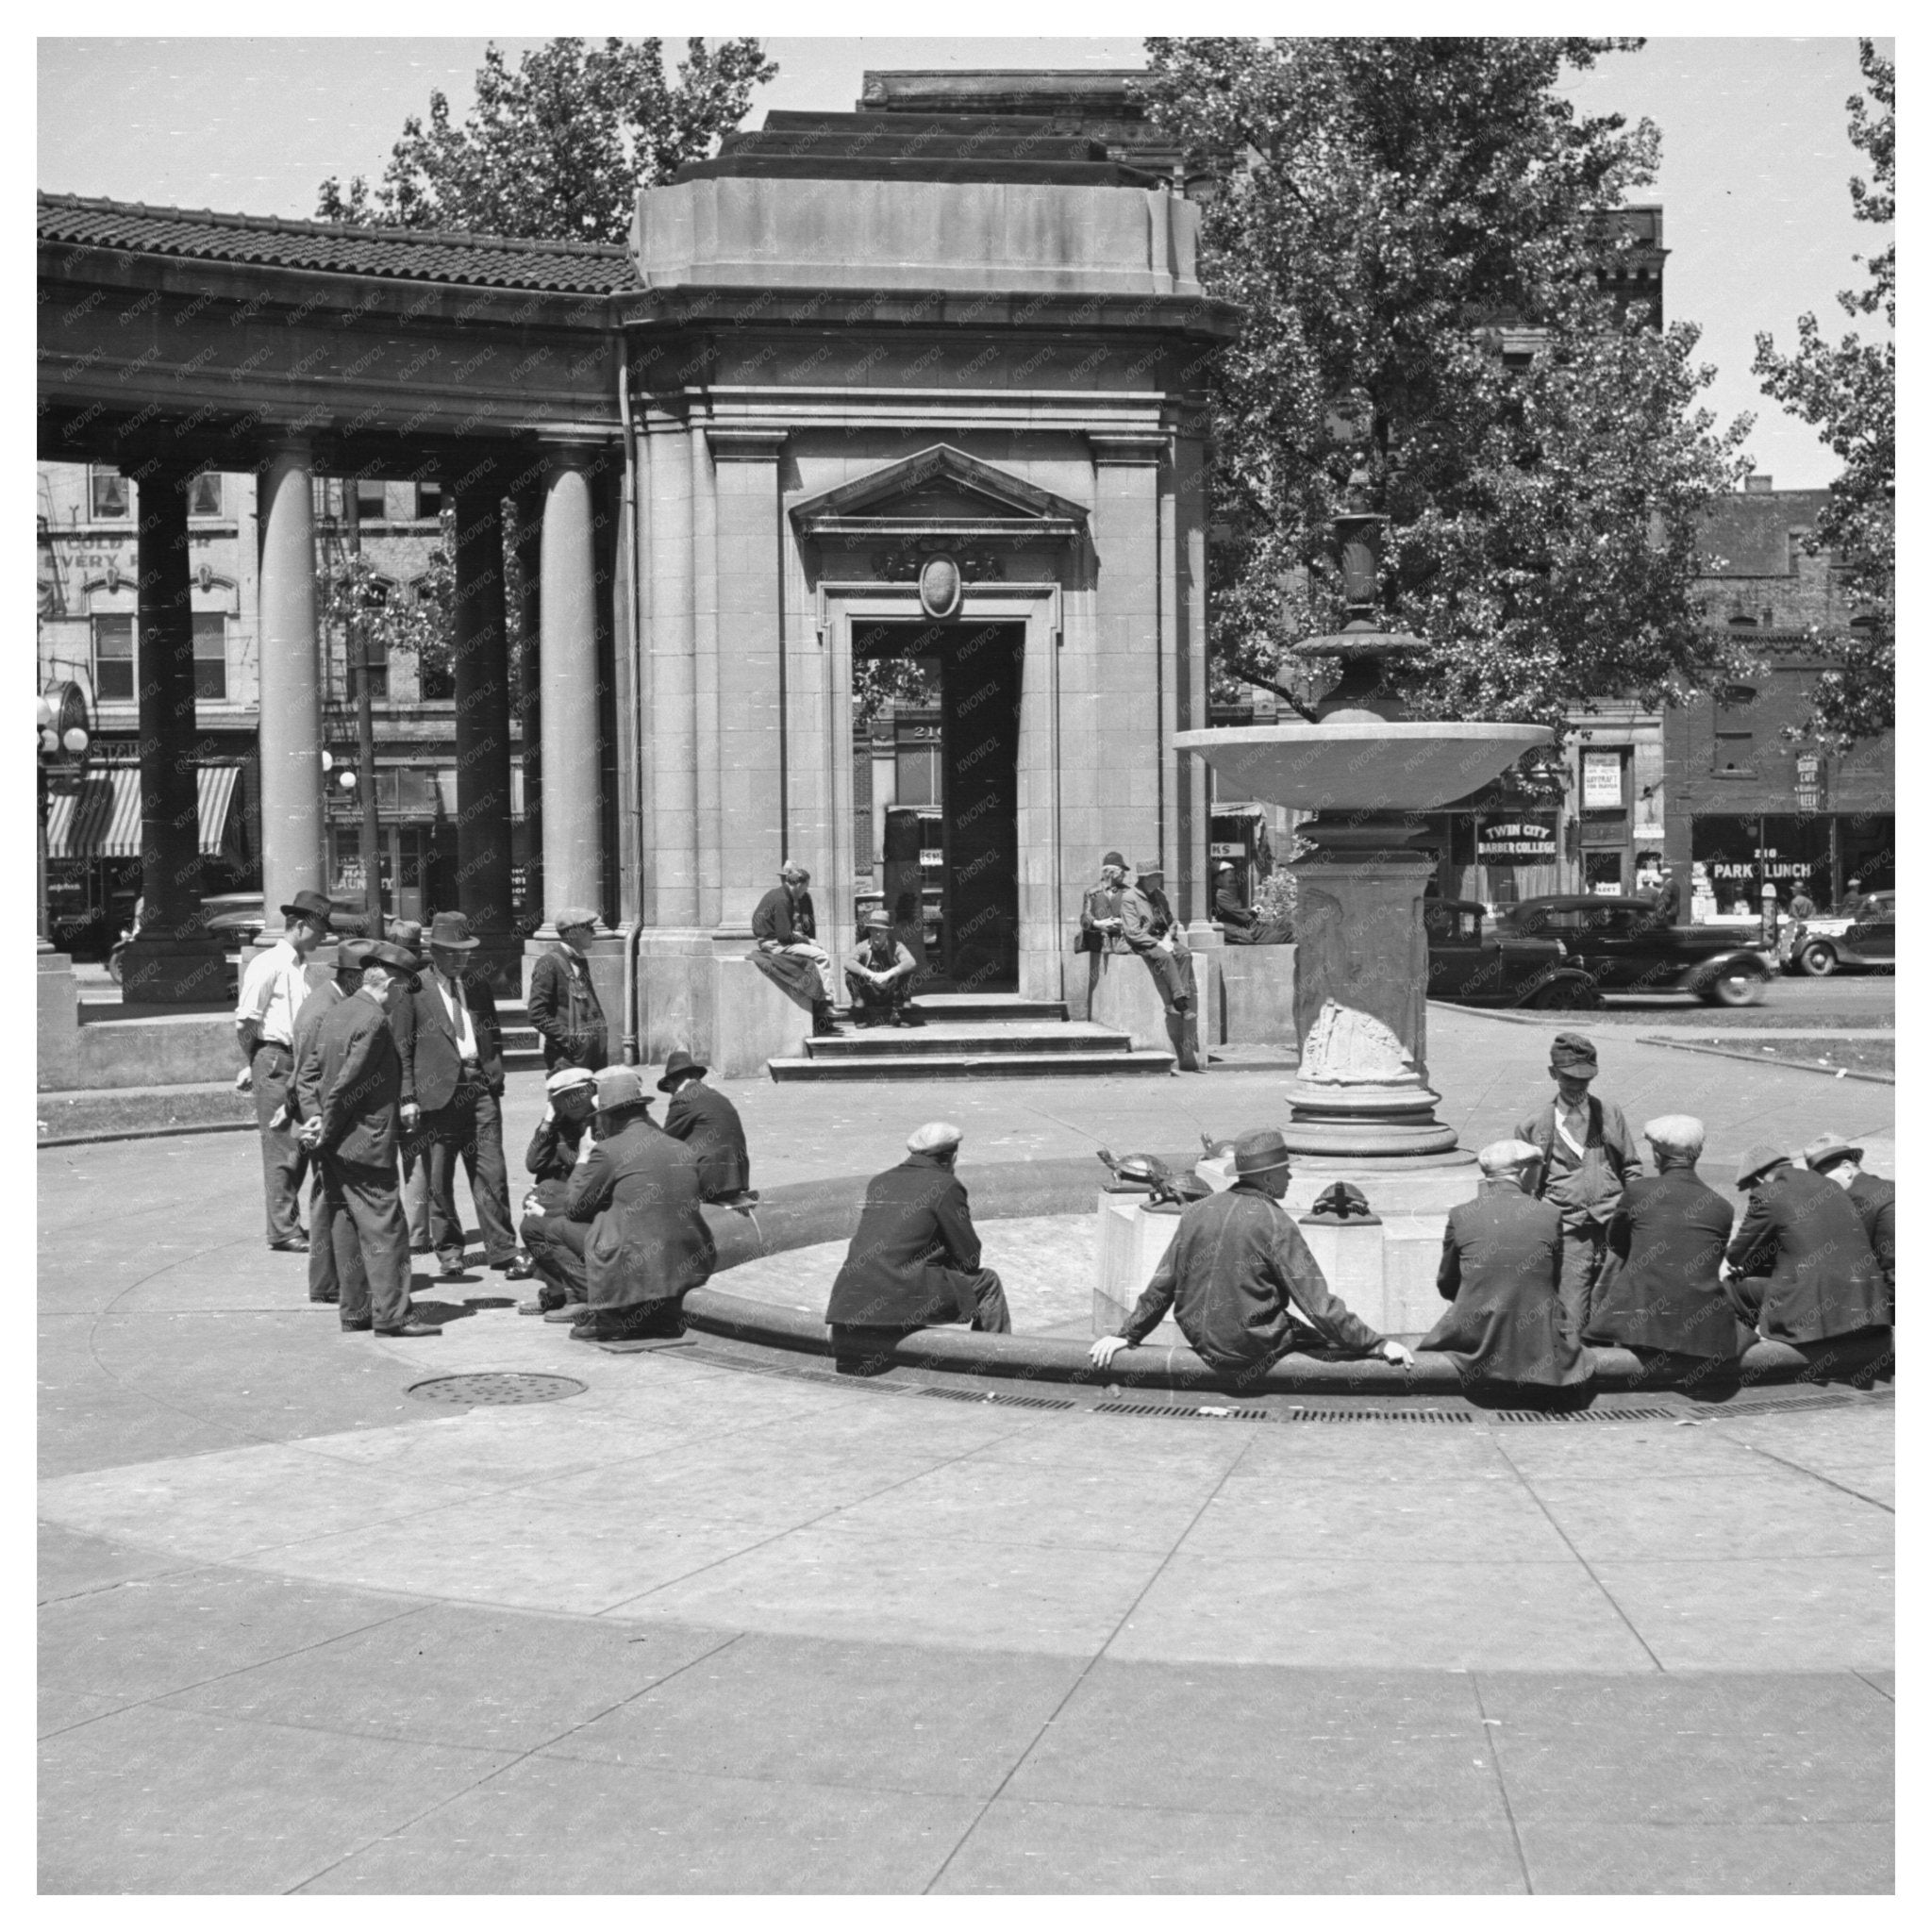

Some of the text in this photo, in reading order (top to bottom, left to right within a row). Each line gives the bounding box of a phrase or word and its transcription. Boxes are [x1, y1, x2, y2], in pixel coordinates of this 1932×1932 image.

[1485, 824, 1551, 840] TWIN CITY
[1478, 841, 1557, 854] BARBER COLLEGE
[1714, 863, 1811, 878] PARK LUNCH
